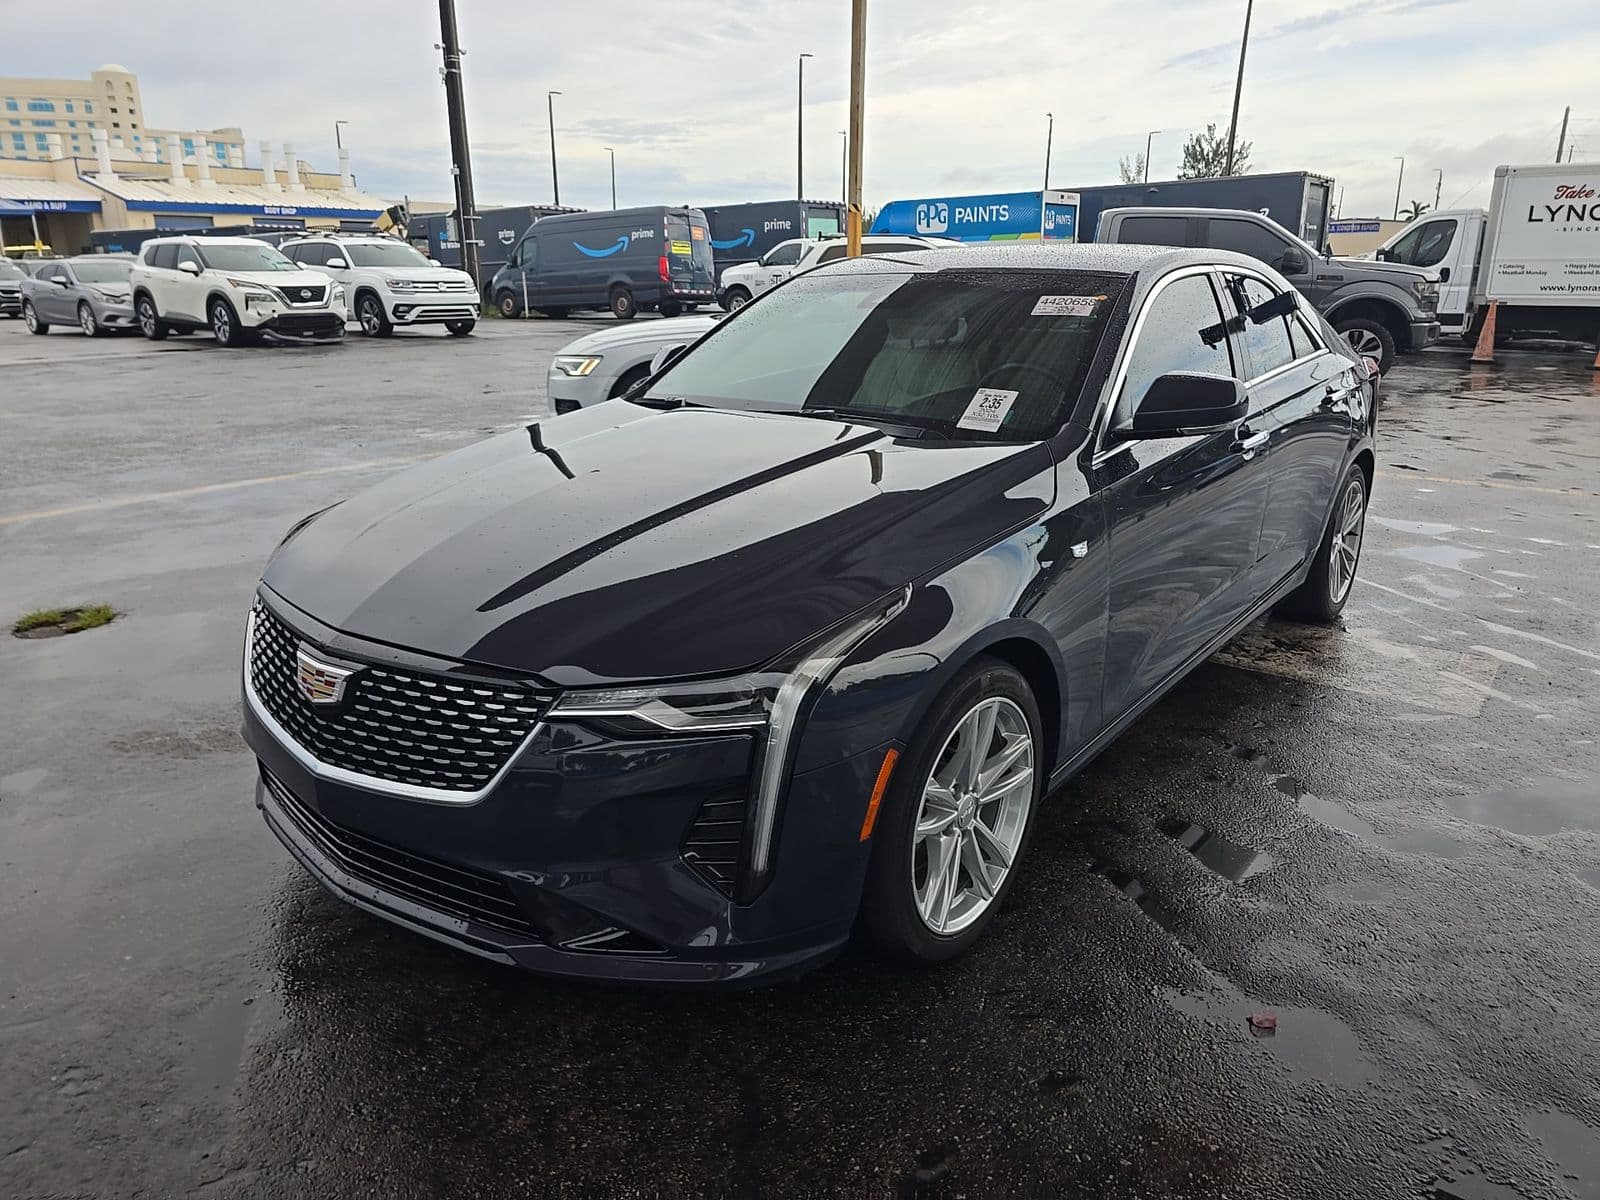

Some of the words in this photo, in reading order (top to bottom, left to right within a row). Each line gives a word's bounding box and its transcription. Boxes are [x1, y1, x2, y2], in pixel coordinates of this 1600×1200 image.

[1554, 184, 1595, 200] Take
[917, 203, 948, 230] PPG
[955, 204, 1009, 224] PAINTS
[1056, 214, 1072, 225] PAINTS
[764, 218, 792, 233] prime
[631, 228, 655, 241] prime
[979, 397, 1003, 410] 2:35
